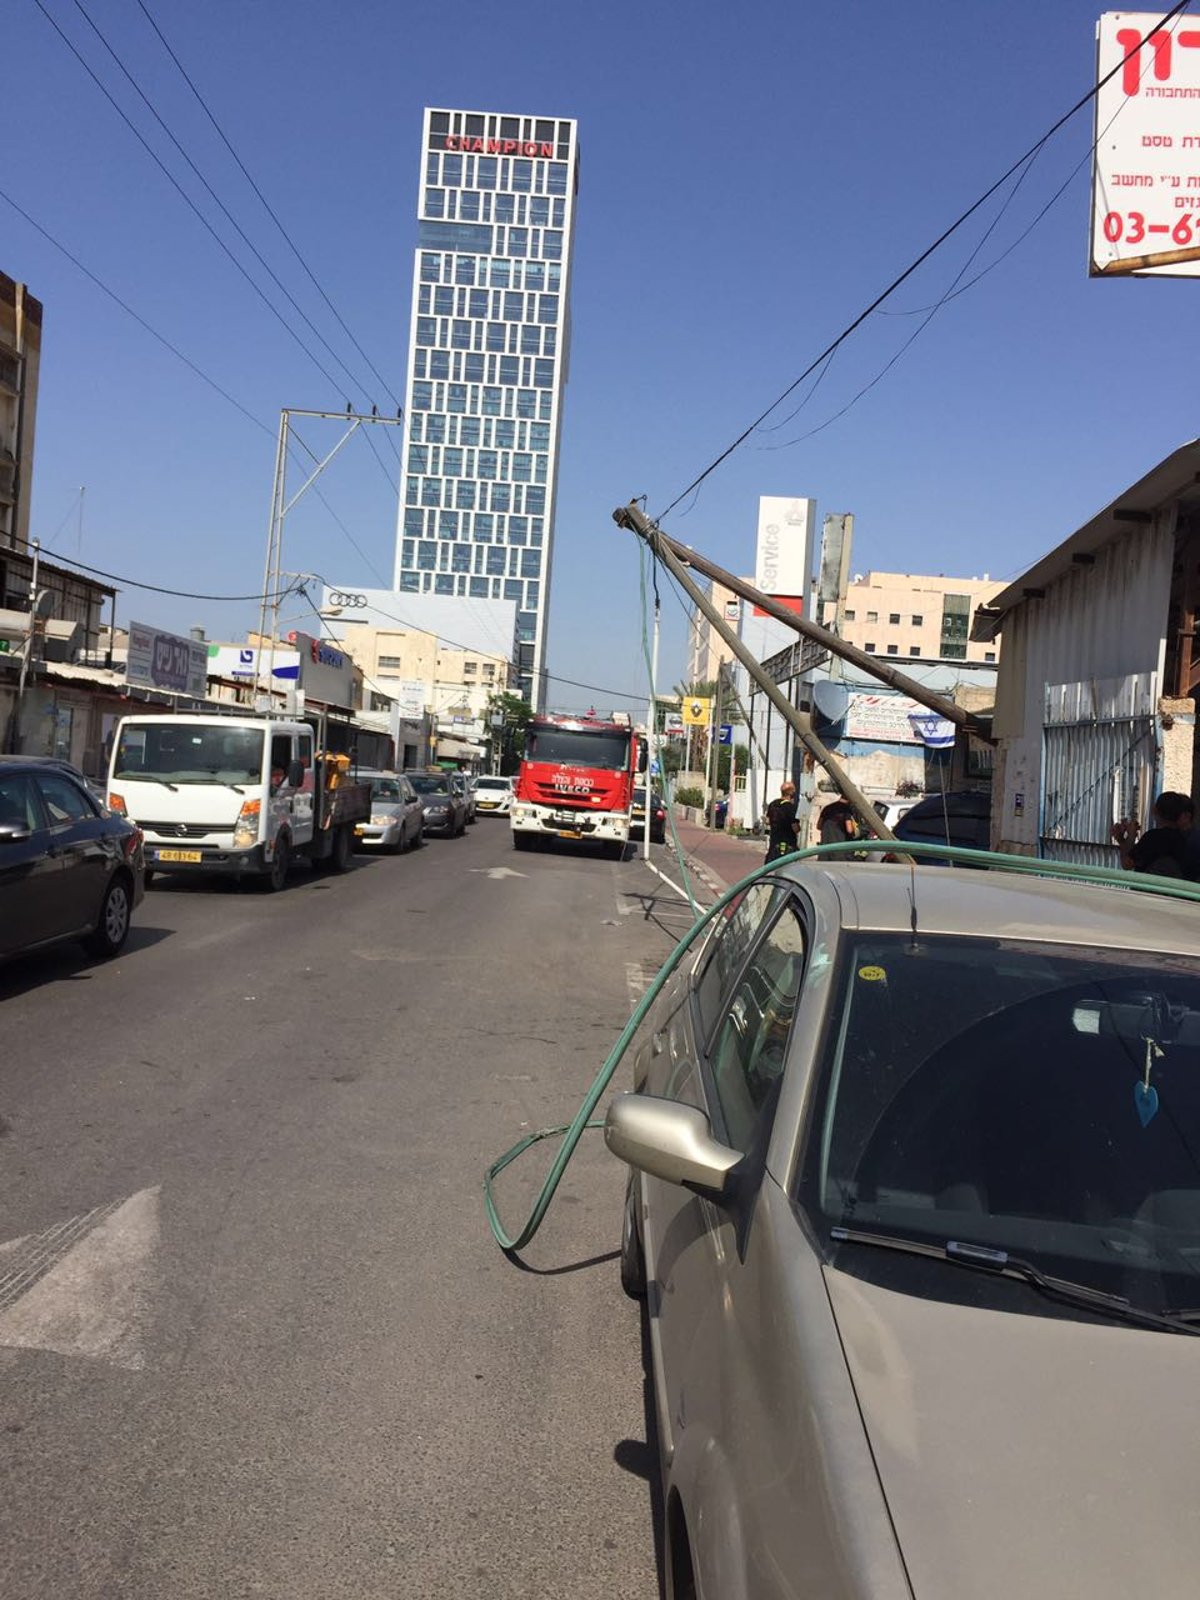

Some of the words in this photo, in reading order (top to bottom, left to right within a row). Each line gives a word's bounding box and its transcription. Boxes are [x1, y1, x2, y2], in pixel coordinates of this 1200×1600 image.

[445, 135, 554, 158] CHAMPION
[1142, 136, 1173, 147] טסט
[1111, 174, 1154, 187] מחשב
[760, 523, 780, 591] Service
[554, 784, 590, 794] IVECO
